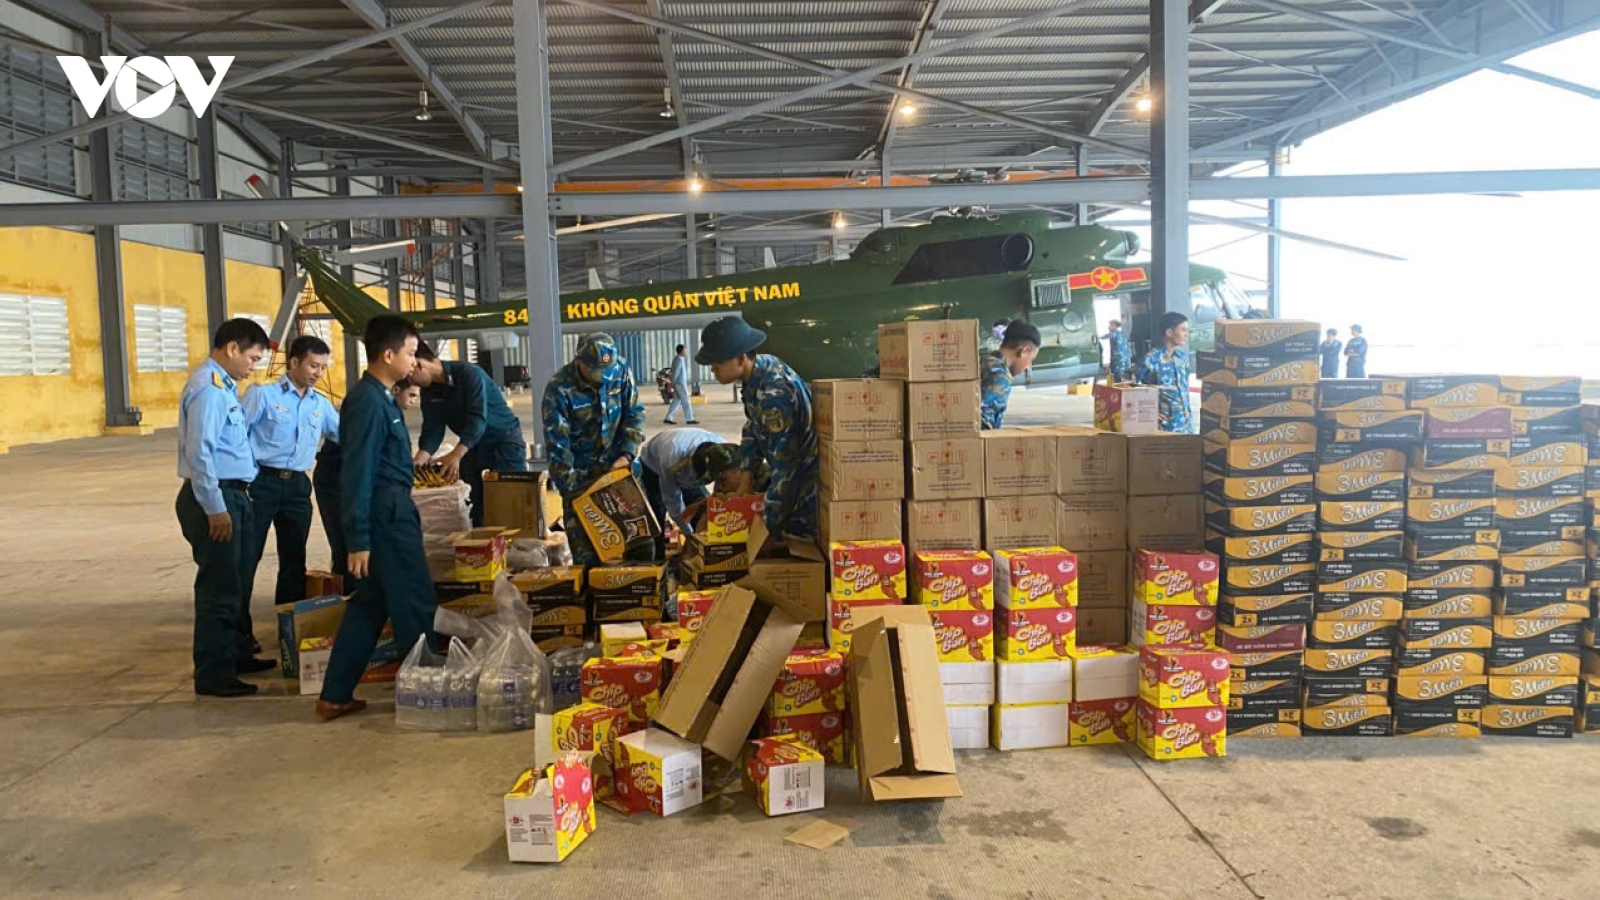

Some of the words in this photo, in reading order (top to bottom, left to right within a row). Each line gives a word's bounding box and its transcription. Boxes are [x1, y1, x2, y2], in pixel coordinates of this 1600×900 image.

[567, 296, 639, 320] KHÔNG
[644, 291, 700, 313] QUÂN
[704, 287, 748, 305] VIỆT
[753, 282, 800, 301] NAM
[1168, 670, 1202, 687] Chip
[1162, 723, 1196, 739] Chip
